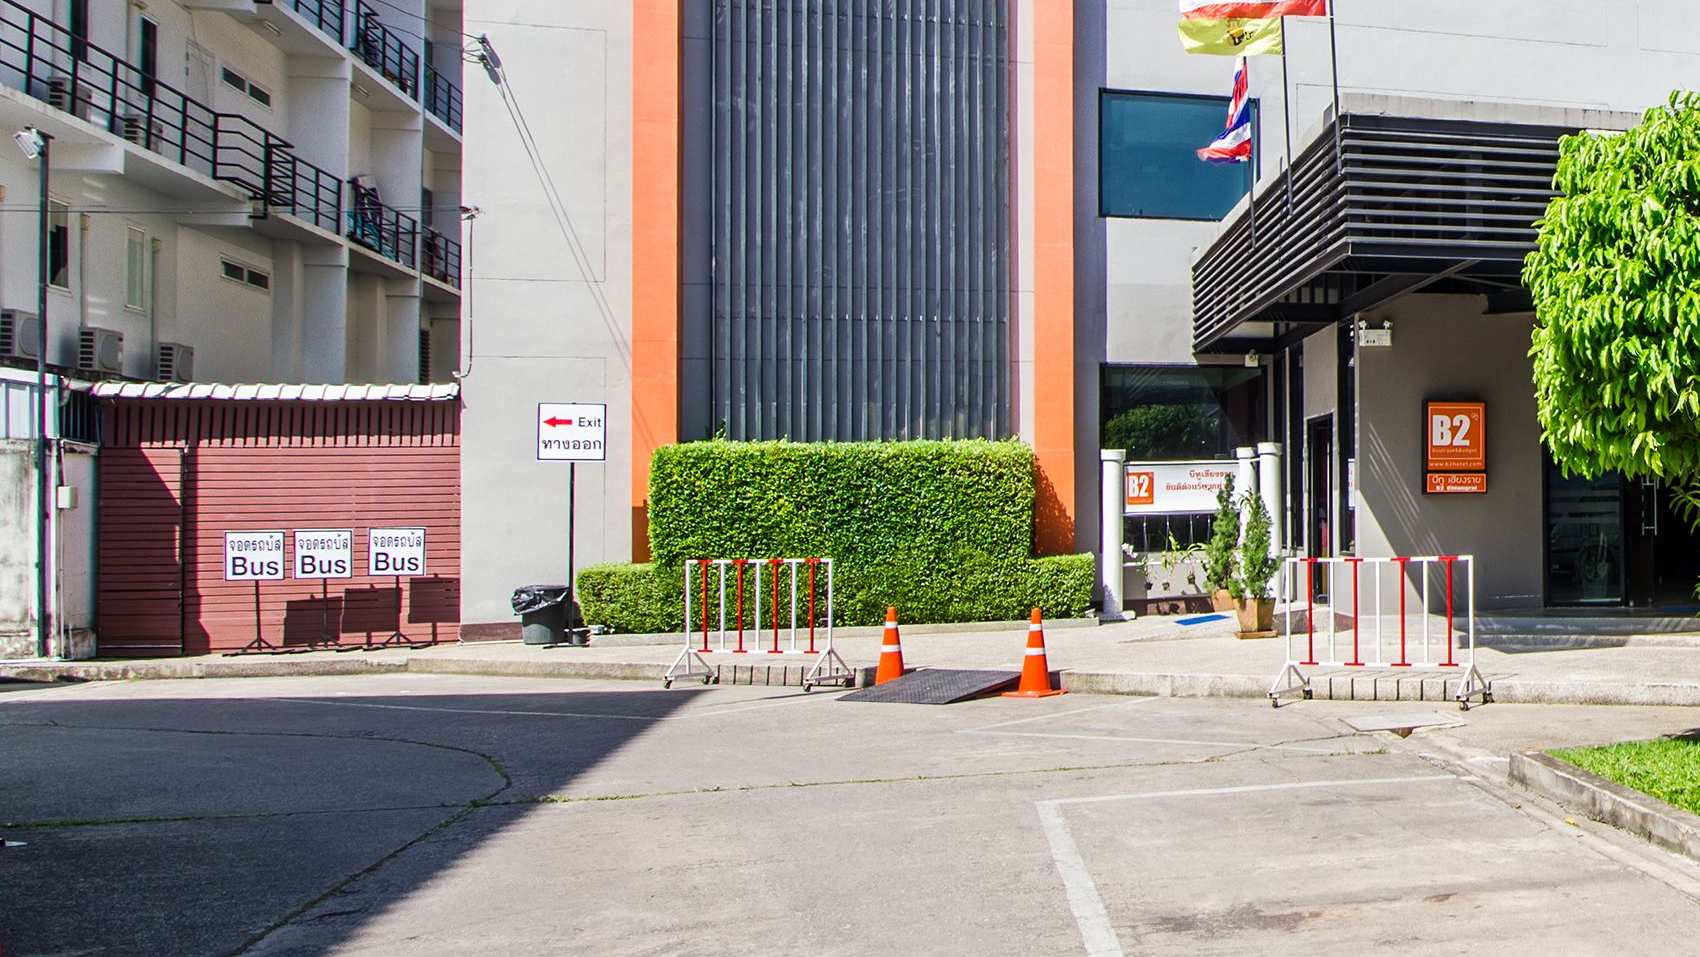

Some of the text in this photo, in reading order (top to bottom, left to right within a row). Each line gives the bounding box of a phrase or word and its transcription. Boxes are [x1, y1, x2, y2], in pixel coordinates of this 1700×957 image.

[578, 416, 602, 428] Exit
[1432, 414, 1470, 447] B2
[541, 439, 602, 450] ทางออก
[1128, 474, 1150, 498] B2
[229, 535, 281, 552] จอดรถบัส
[298, 533, 349, 550] จอดรถบัส
[372, 531, 422, 548] จอดรถบัส
[231, 556, 279, 576] Bus
[301, 555, 347, 574] Bus
[374, 552, 420, 572] Bus
